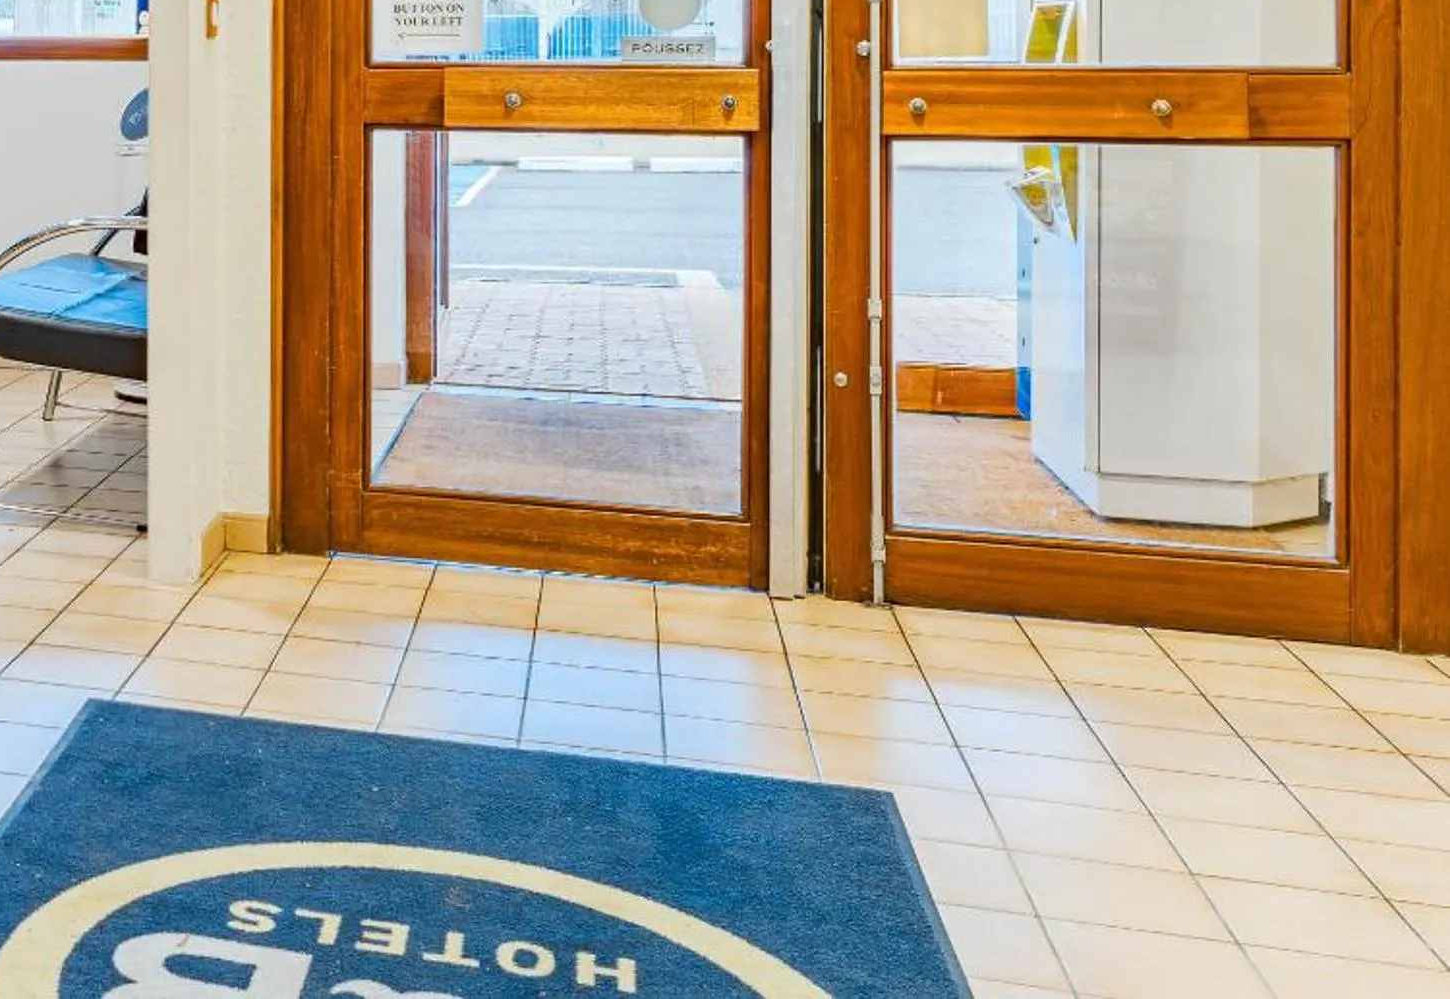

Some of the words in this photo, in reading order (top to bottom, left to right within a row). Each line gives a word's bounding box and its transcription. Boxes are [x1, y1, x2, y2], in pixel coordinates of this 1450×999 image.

[393, 4, 443, 14] BUTTON
[395, 17, 429, 26] YOUR
[431, 16, 464, 26] LEFT
[631, 42, 705, 54] POUSSEZ
[227, 899, 638, 994] HOTELS
